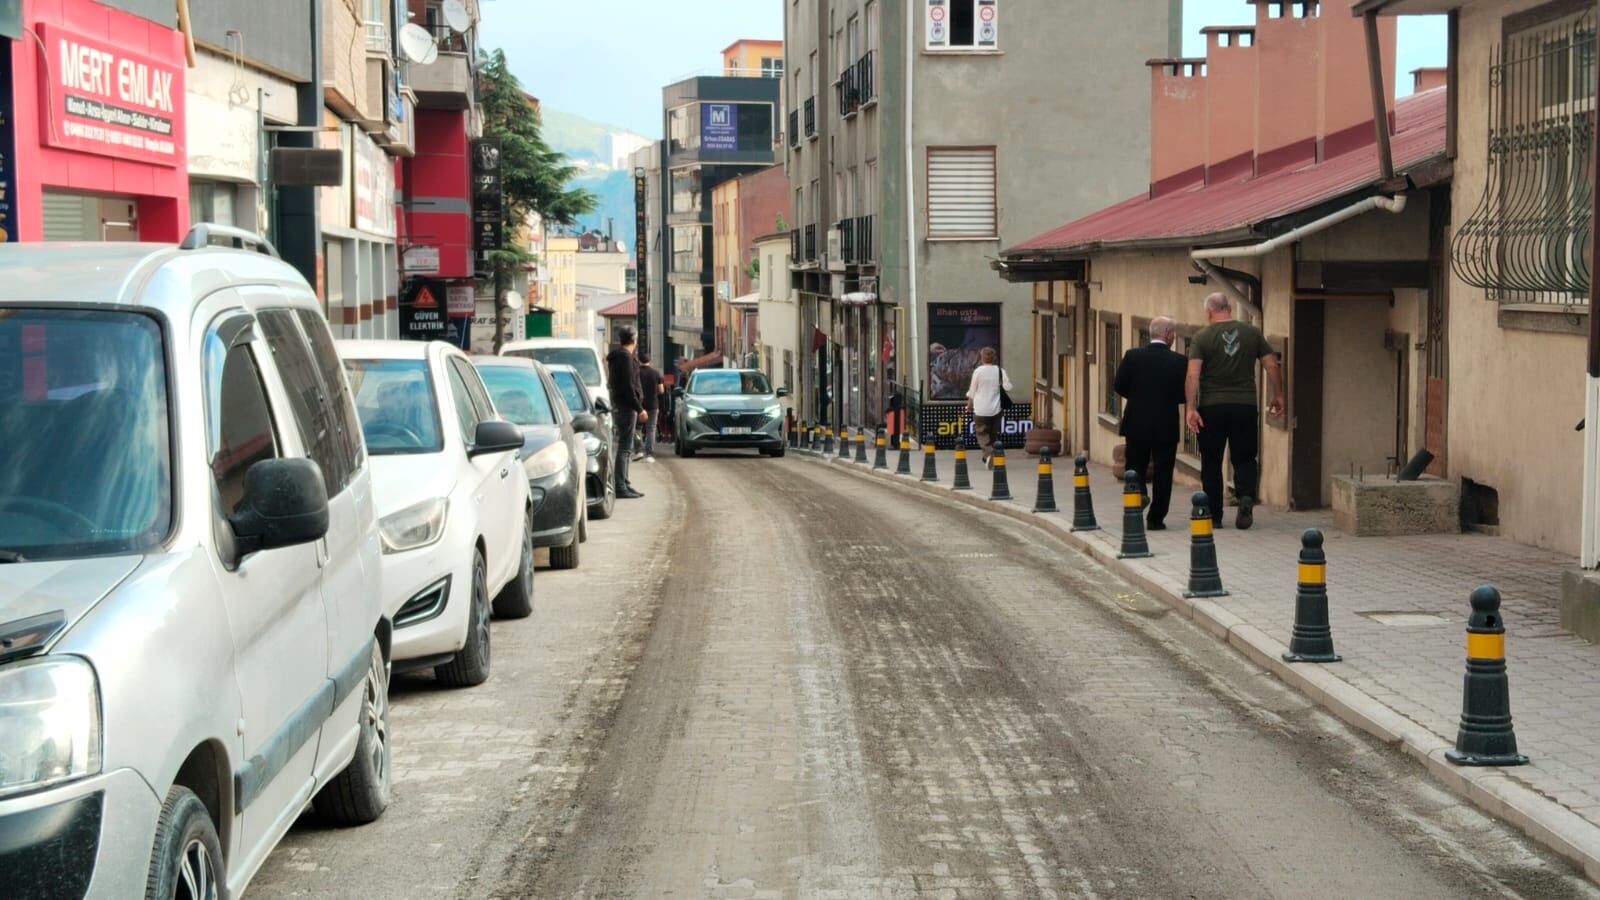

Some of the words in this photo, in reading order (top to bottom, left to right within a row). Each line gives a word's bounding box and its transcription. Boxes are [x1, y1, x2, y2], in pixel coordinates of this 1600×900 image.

[60, 39, 114, 97] MERT
[118, 58, 174, 112] EMLAK
[414, 310, 439, 321] GÜVEN
[409, 320, 444, 331] ELEKTRİK
[938, 416, 963, 435] art
[969, 416, 1033, 434] rlam
